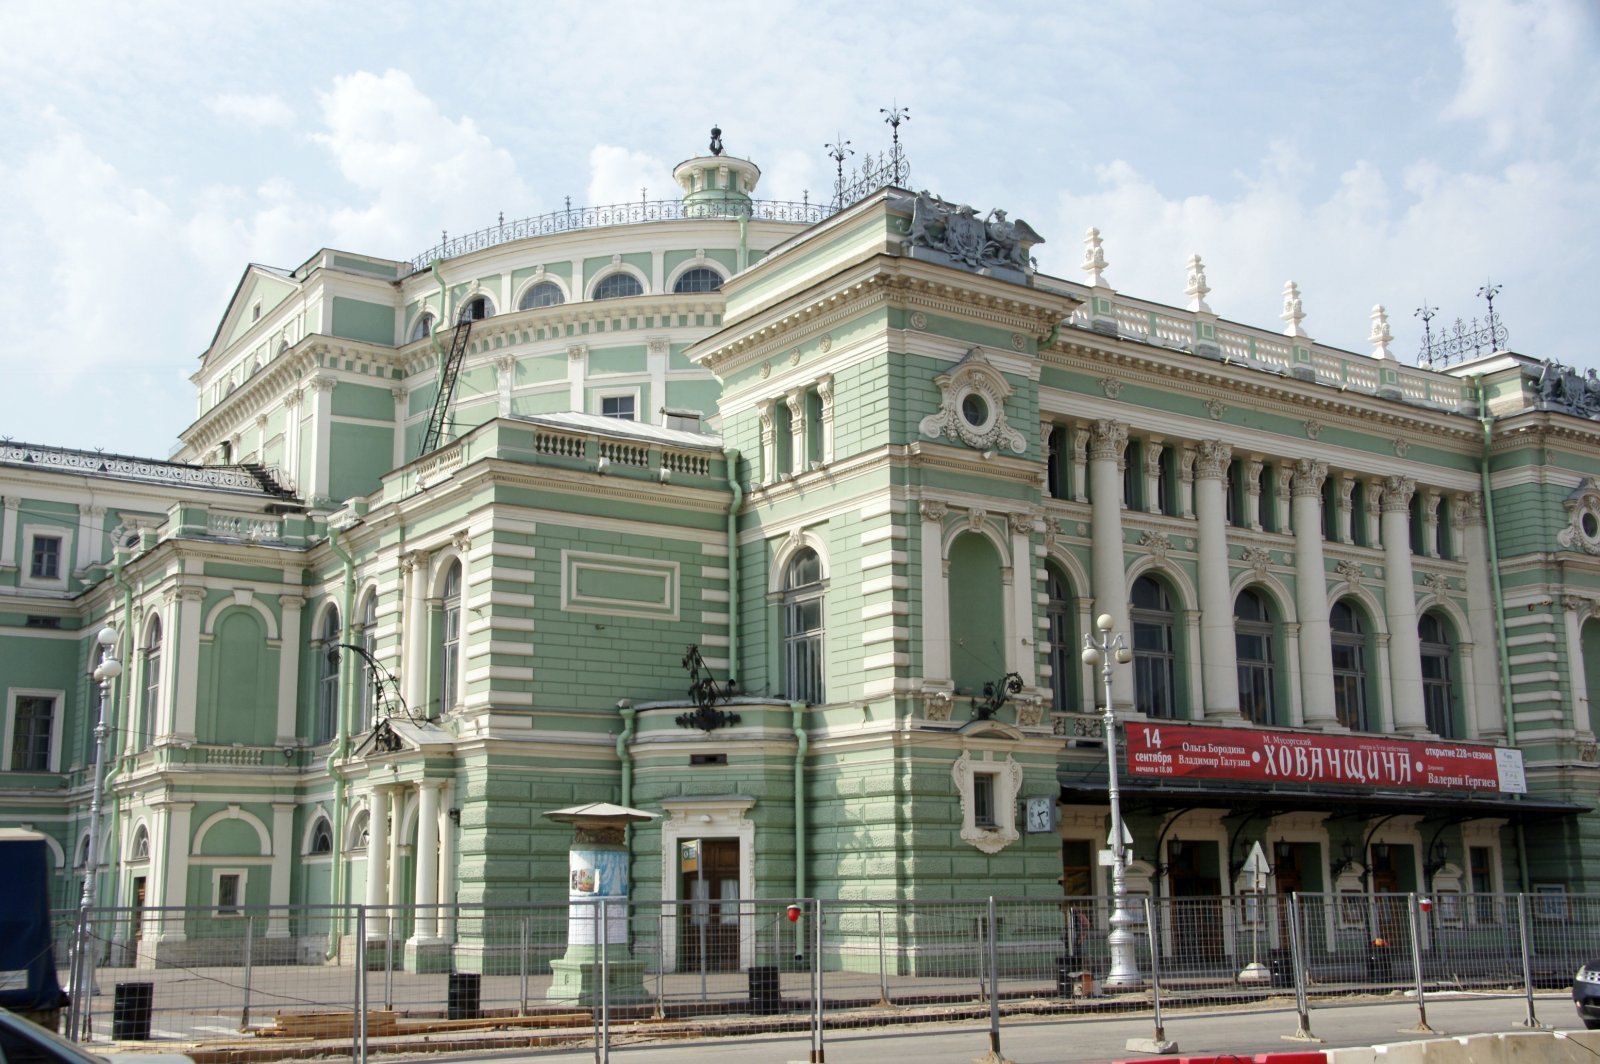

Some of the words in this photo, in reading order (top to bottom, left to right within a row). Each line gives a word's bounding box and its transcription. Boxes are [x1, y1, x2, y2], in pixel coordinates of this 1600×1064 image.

[1143, 728, 1161, 748] 14
[1273, 736, 1312, 746] Мусоргский
[1182, 742, 1207, 753] Ольга
[1208, 744, 1245, 756] Бородина
[1425, 748, 1455, 759] открытие
[1472, 751, 1492, 760] сезона
[1135, 752, 1172, 764] сентября
[1178, 754, 1219, 768] Владимир
[1220, 757, 1251, 768] Галузин
[1264, 744, 1411, 785] ХОВАНЩИНА
[1159, 766, 1173, 774] 18.00
[1428, 773, 1463, 787] Валерий
[1465, 775, 1496, 789] Гергиев
